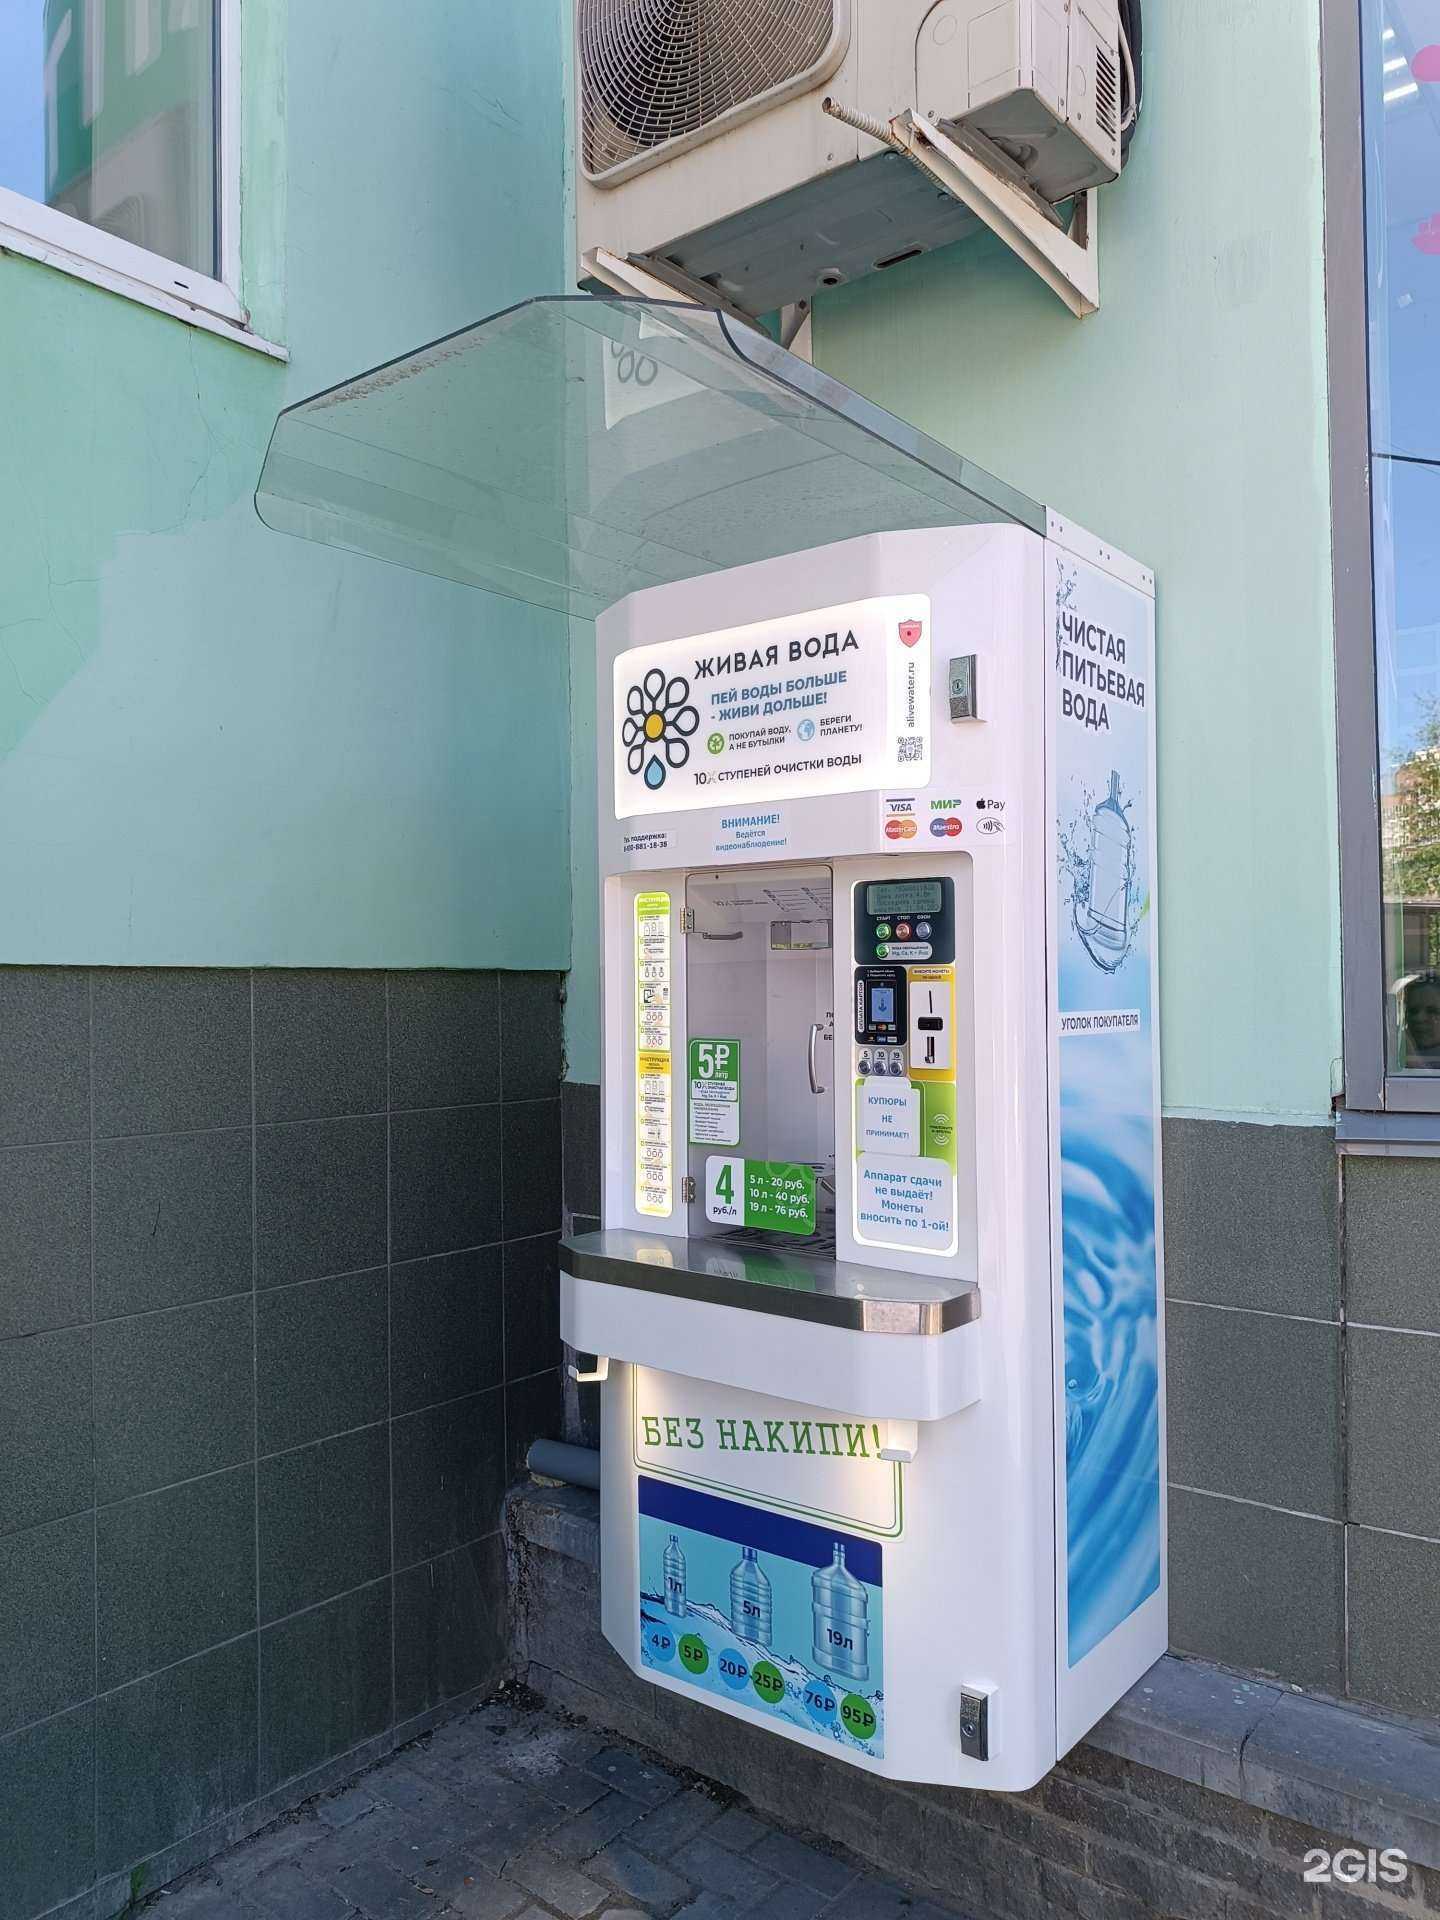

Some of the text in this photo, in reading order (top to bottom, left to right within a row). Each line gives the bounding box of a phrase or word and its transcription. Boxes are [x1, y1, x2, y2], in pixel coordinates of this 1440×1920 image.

[1062, 611, 1125, 664] ЧИСТАЯ
[694, 630, 859, 679] ЖИВАЯ ВОДА
[1063, 650, 1144, 707] ПИТЬЕВАЯ
[711, 671, 847, 705] ПЕЙ ВОДЫ БОЛЬШЕ
[907, 662, 915, 727] alivewater.ru
[719, 704, 759, 721] ЖИВИ
[763, 692, 827, 716] ДОЛЬШЕ!
[1063, 688, 1109, 731] ВОДА
[820, 715, 851, 726] БЕРЕГИ
[729, 729, 766, 741] ПОКУПАЙ
[820, 724, 862, 737] ПЛАНЕТУ!
[736, 741, 747, 749] НЕ
[748, 736, 785, 748] БУТЫЛКИ
[718, 764, 771, 781] СТУПЕНЕЙ
[774, 759, 824, 774] ОЧИСТКИ
[827, 754, 862, 768] ВОДЫ
[889, 803, 912, 812] VISA
[930, 799, 962, 810] МИР
[987, 799, 1005, 811] Pay
[721, 814, 780, 829] ВНИМАНИЕ!
[1061, 1014, 1139, 1030] УГОЛОК ПОКУПАТЕЛЯ
[868, 1096, 907, 1107] КУПЮРЫ
[881, 1114, 893, 1123] НЕ
[715, 1164, 735, 1205] 4
[749, 1175, 756, 1184] 5
[771, 1177, 783, 1187] 20
[784, 1180, 805, 1190] руб.
[864, 1169, 942, 1188] Аппарат сдачи
[750, 1188, 760, 1198] 10
[775, 1191, 788, 1201] 40
[790, 1194, 810, 1204] руб.
[875, 1186, 933, 1201] не выдаёт!
[713, 1205, 737, 1216] руб./л
[750, 1202, 759, 1211] 19
[760, 1205, 767, 1213] л
[774, 1205, 786, 1214] 76
[788, 1208, 809, 1218] руб.
[881, 1200, 924, 1213] Монеты
[860, 1213, 949, 1232] вносить по 1-ой!
[641, 1416, 881, 1459] БЕЗ НАКИПИ!
[743, 1600, 761, 1618] 5л
[827, 1628, 853, 1650] 19л
